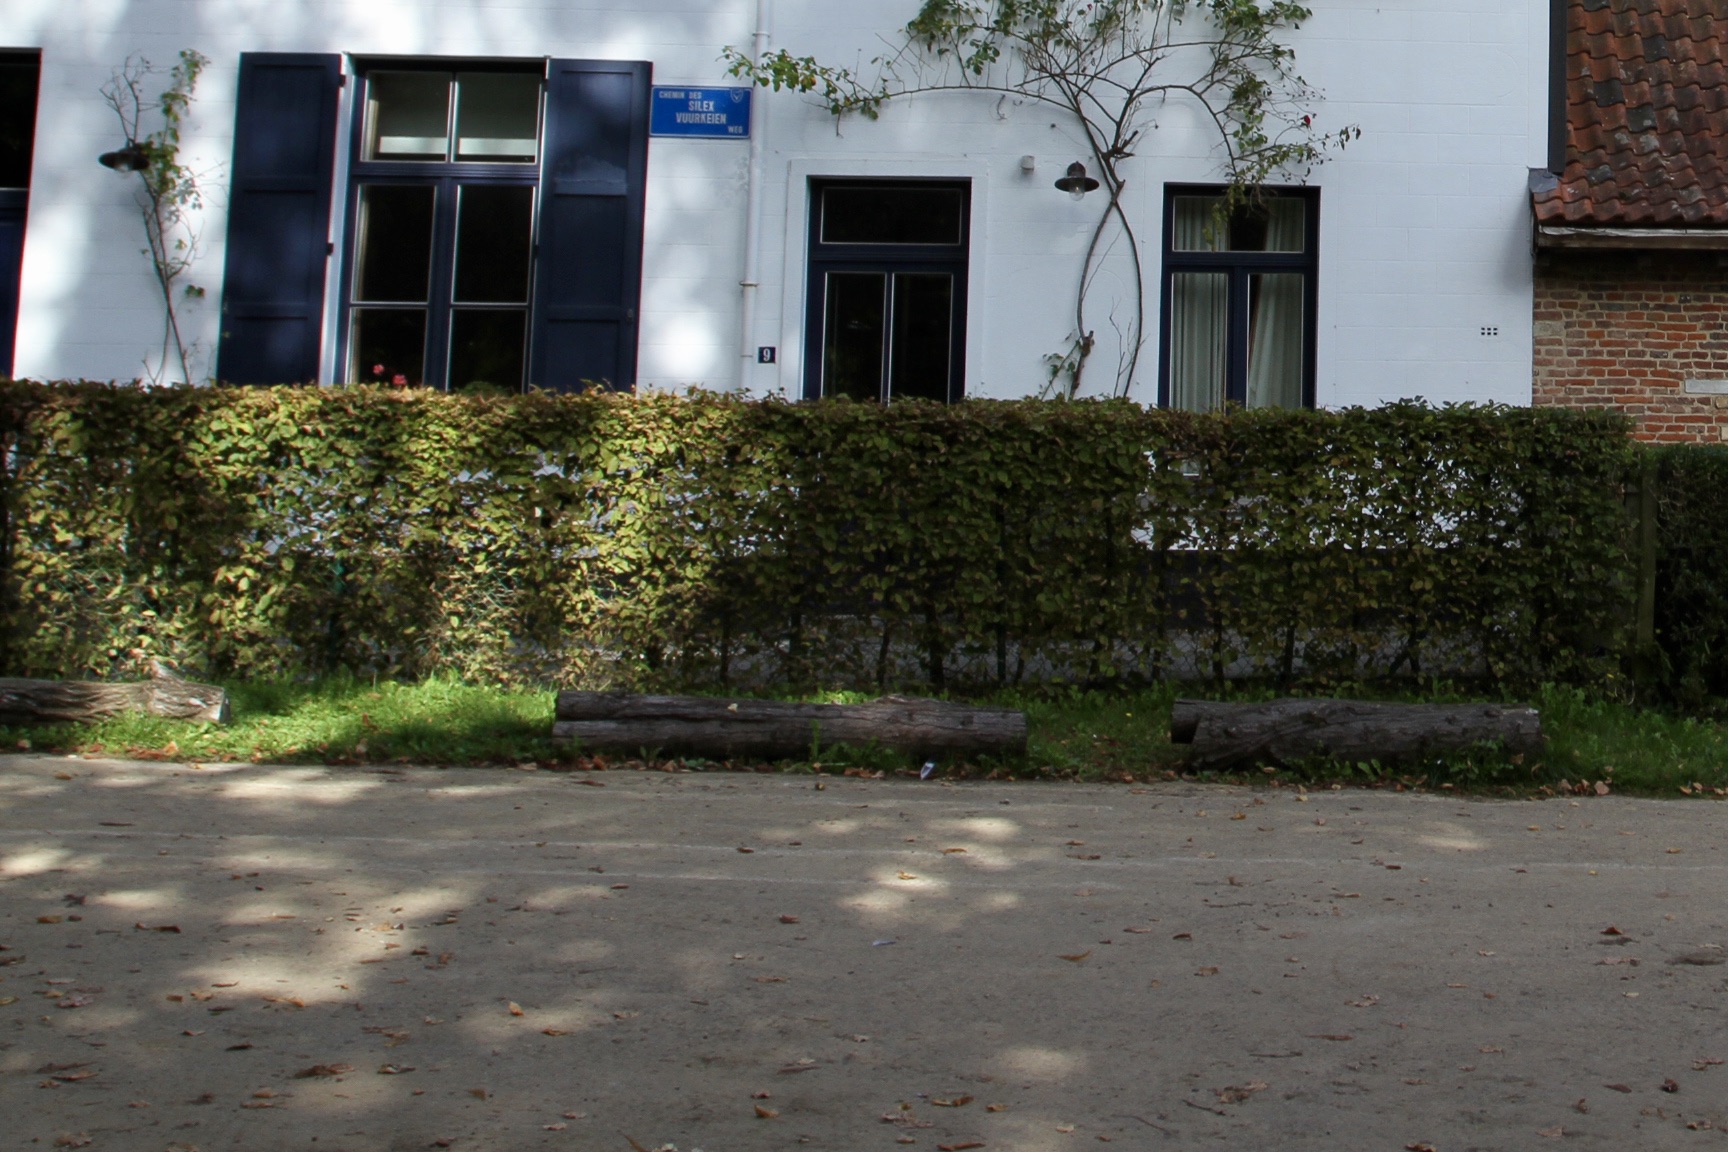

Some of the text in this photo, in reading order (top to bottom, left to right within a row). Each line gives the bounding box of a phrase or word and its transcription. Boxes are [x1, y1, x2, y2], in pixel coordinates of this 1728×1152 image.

[659, 91, 702, 99] CHEMIN DES
[689, 101, 714, 112] SILEX
[676, 113, 727, 124] VUURKEIEN
[728, 126, 743, 134] WEG
[763, 348, 771, 362] 9
